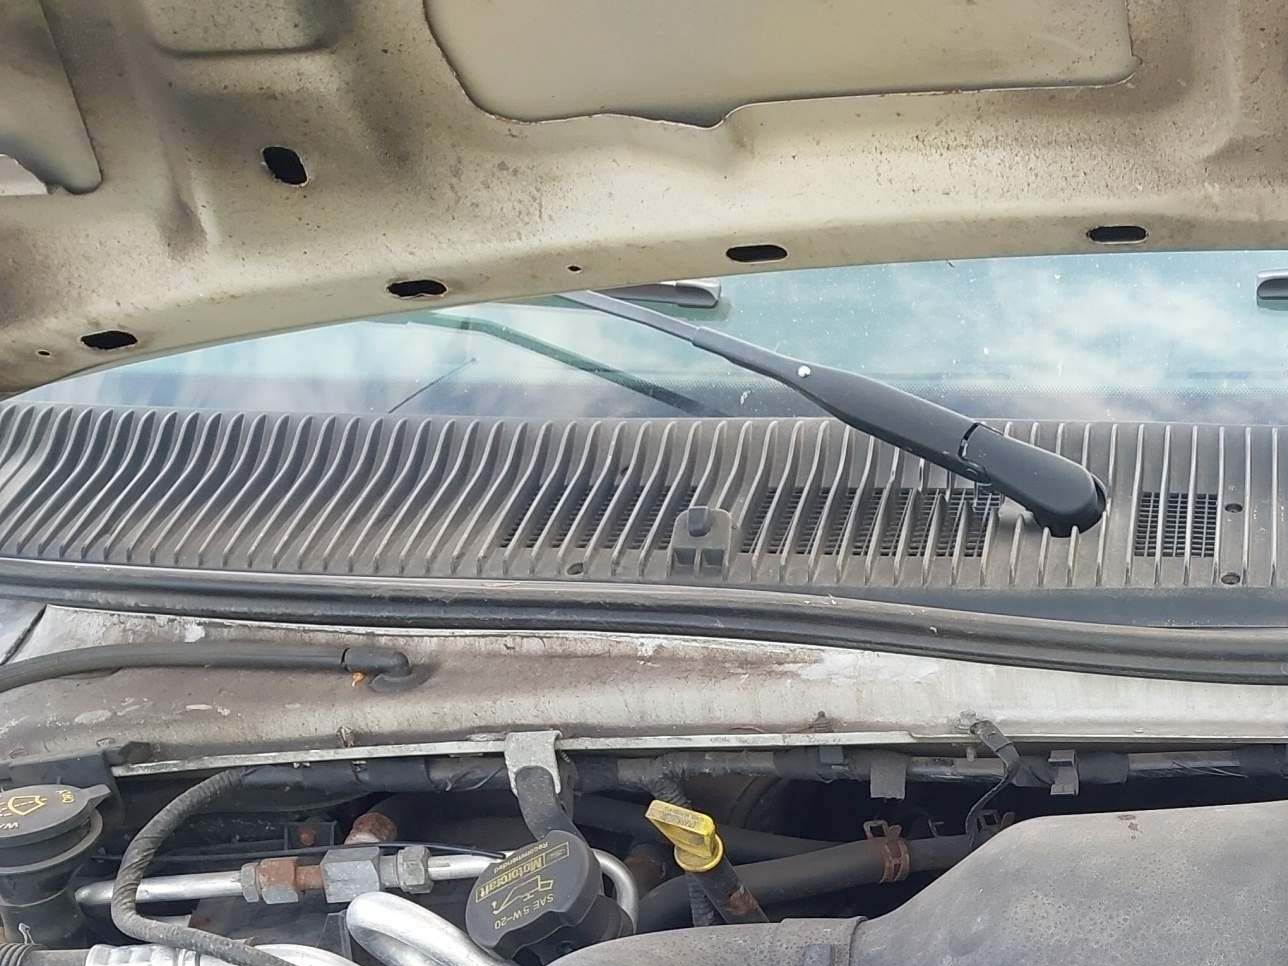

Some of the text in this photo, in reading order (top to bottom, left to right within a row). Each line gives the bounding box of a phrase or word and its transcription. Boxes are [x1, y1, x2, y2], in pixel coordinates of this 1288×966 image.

[493, 841, 549, 875] Recommended
[479, 855, 544, 899] Motorcraft
[532, 893, 554, 912] SAE
